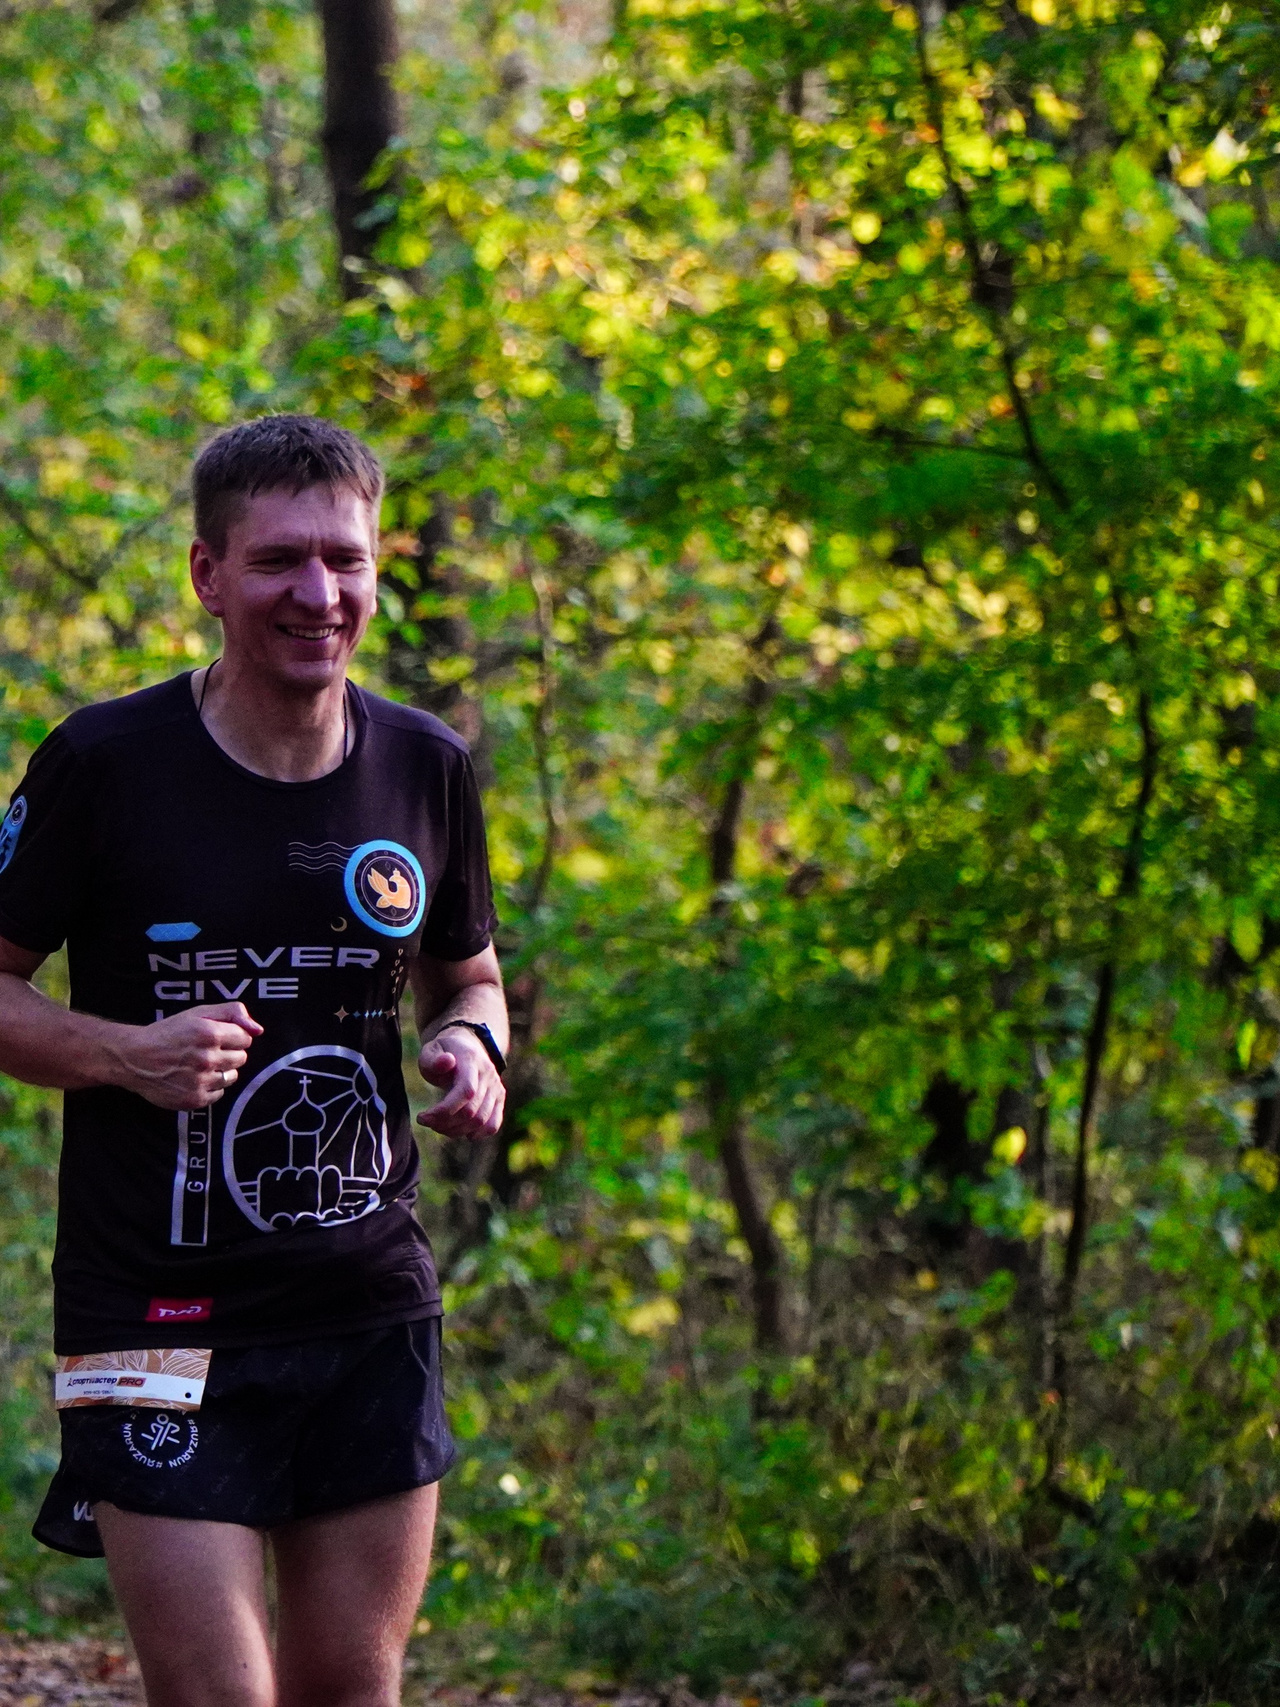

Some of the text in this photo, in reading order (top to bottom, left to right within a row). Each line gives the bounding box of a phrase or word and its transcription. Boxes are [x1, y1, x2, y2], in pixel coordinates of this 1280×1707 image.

[148, 946, 380, 972] NEVER
[154, 977, 299, 1000] GIVE
[118, 1377, 145, 1387] PRO
